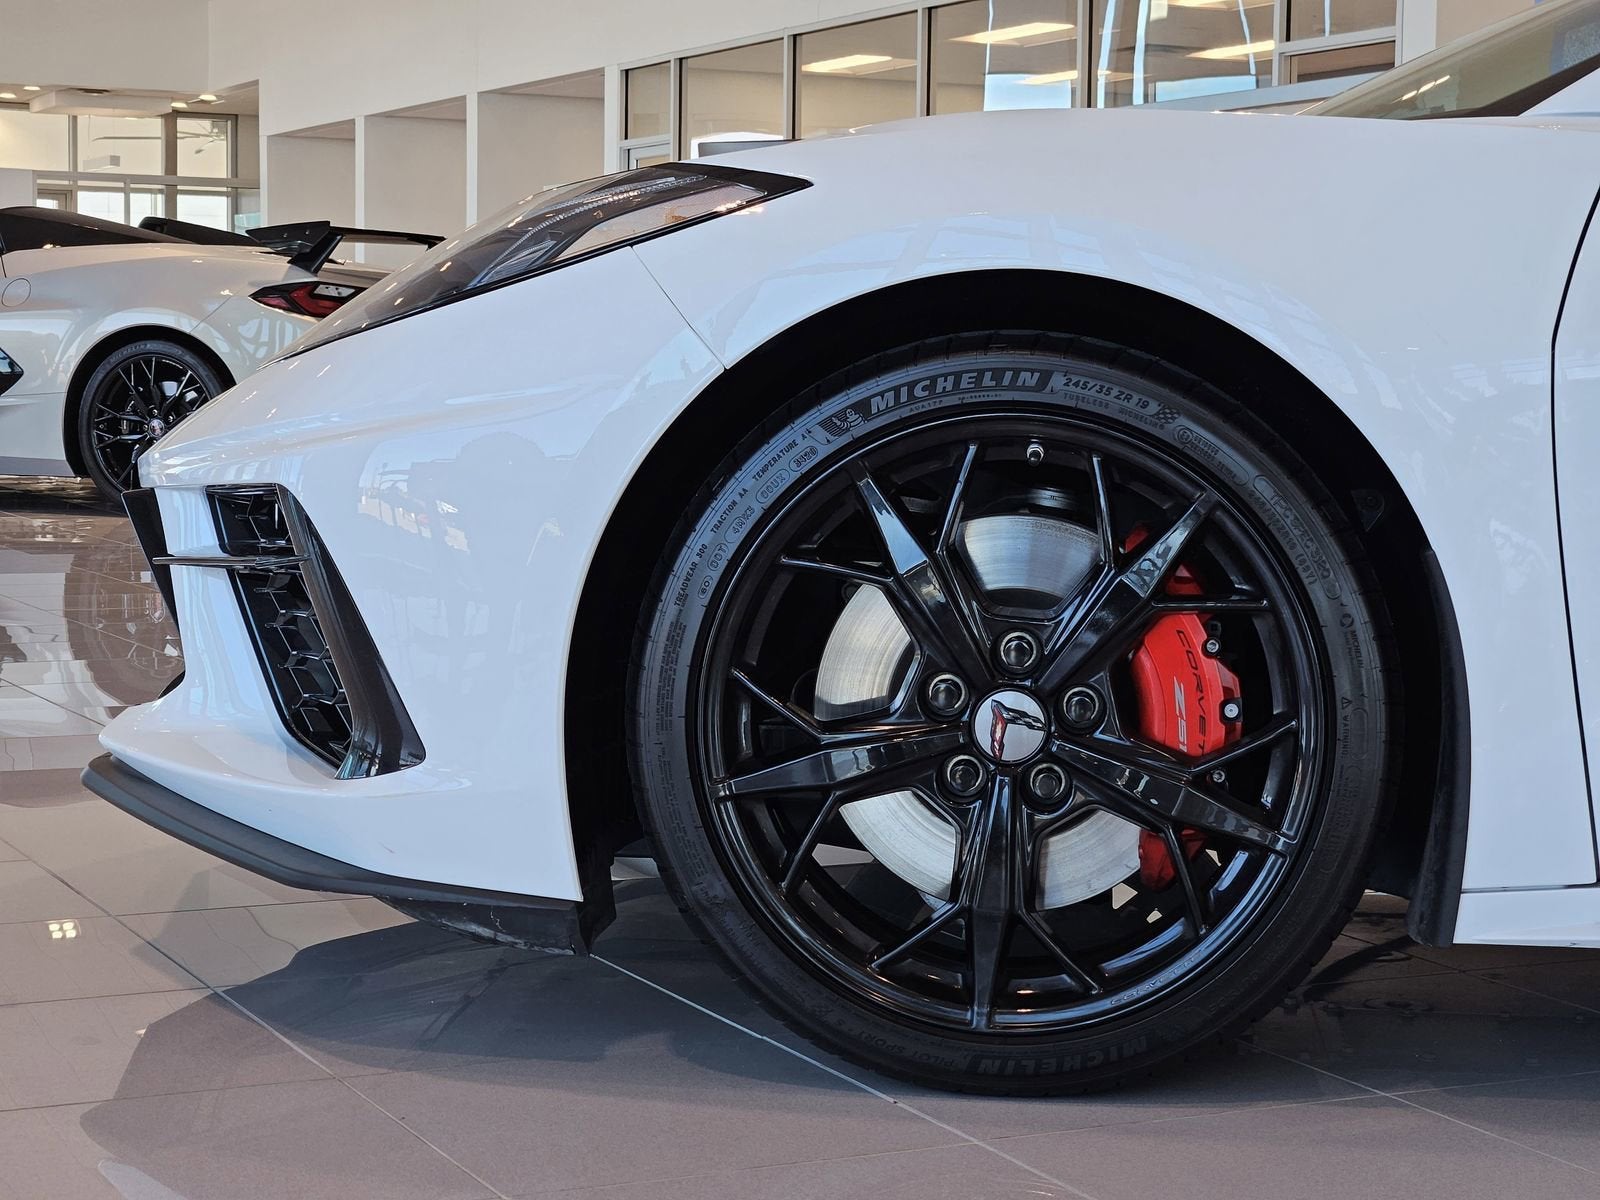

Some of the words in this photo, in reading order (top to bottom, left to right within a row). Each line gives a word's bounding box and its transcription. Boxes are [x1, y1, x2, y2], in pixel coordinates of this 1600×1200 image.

[870, 371, 1040, 414] MICHELIN
[1063, 377, 1113, 397] 245/35
[1114, 389, 1134, 404] ZR
[1136, 398, 1150, 410] 19
[673, 562, 699, 607] TREADWEAR
[710, 499, 738, 534] TRACTION
[738, 487, 749, 499] AA
[751, 439, 799, 482] TEMPERATURE
[800, 433, 808, 441] A
[709, 544, 727, 569] DOT
[1350, 630, 1364, 668] MICHELIN
[1176, 629, 1206, 755] CORVET
[1173, 675, 1187, 752] Z51
[857, 1029, 906, 1055] SPORT
[978, 1037, 1148, 1075] MICHELIN
